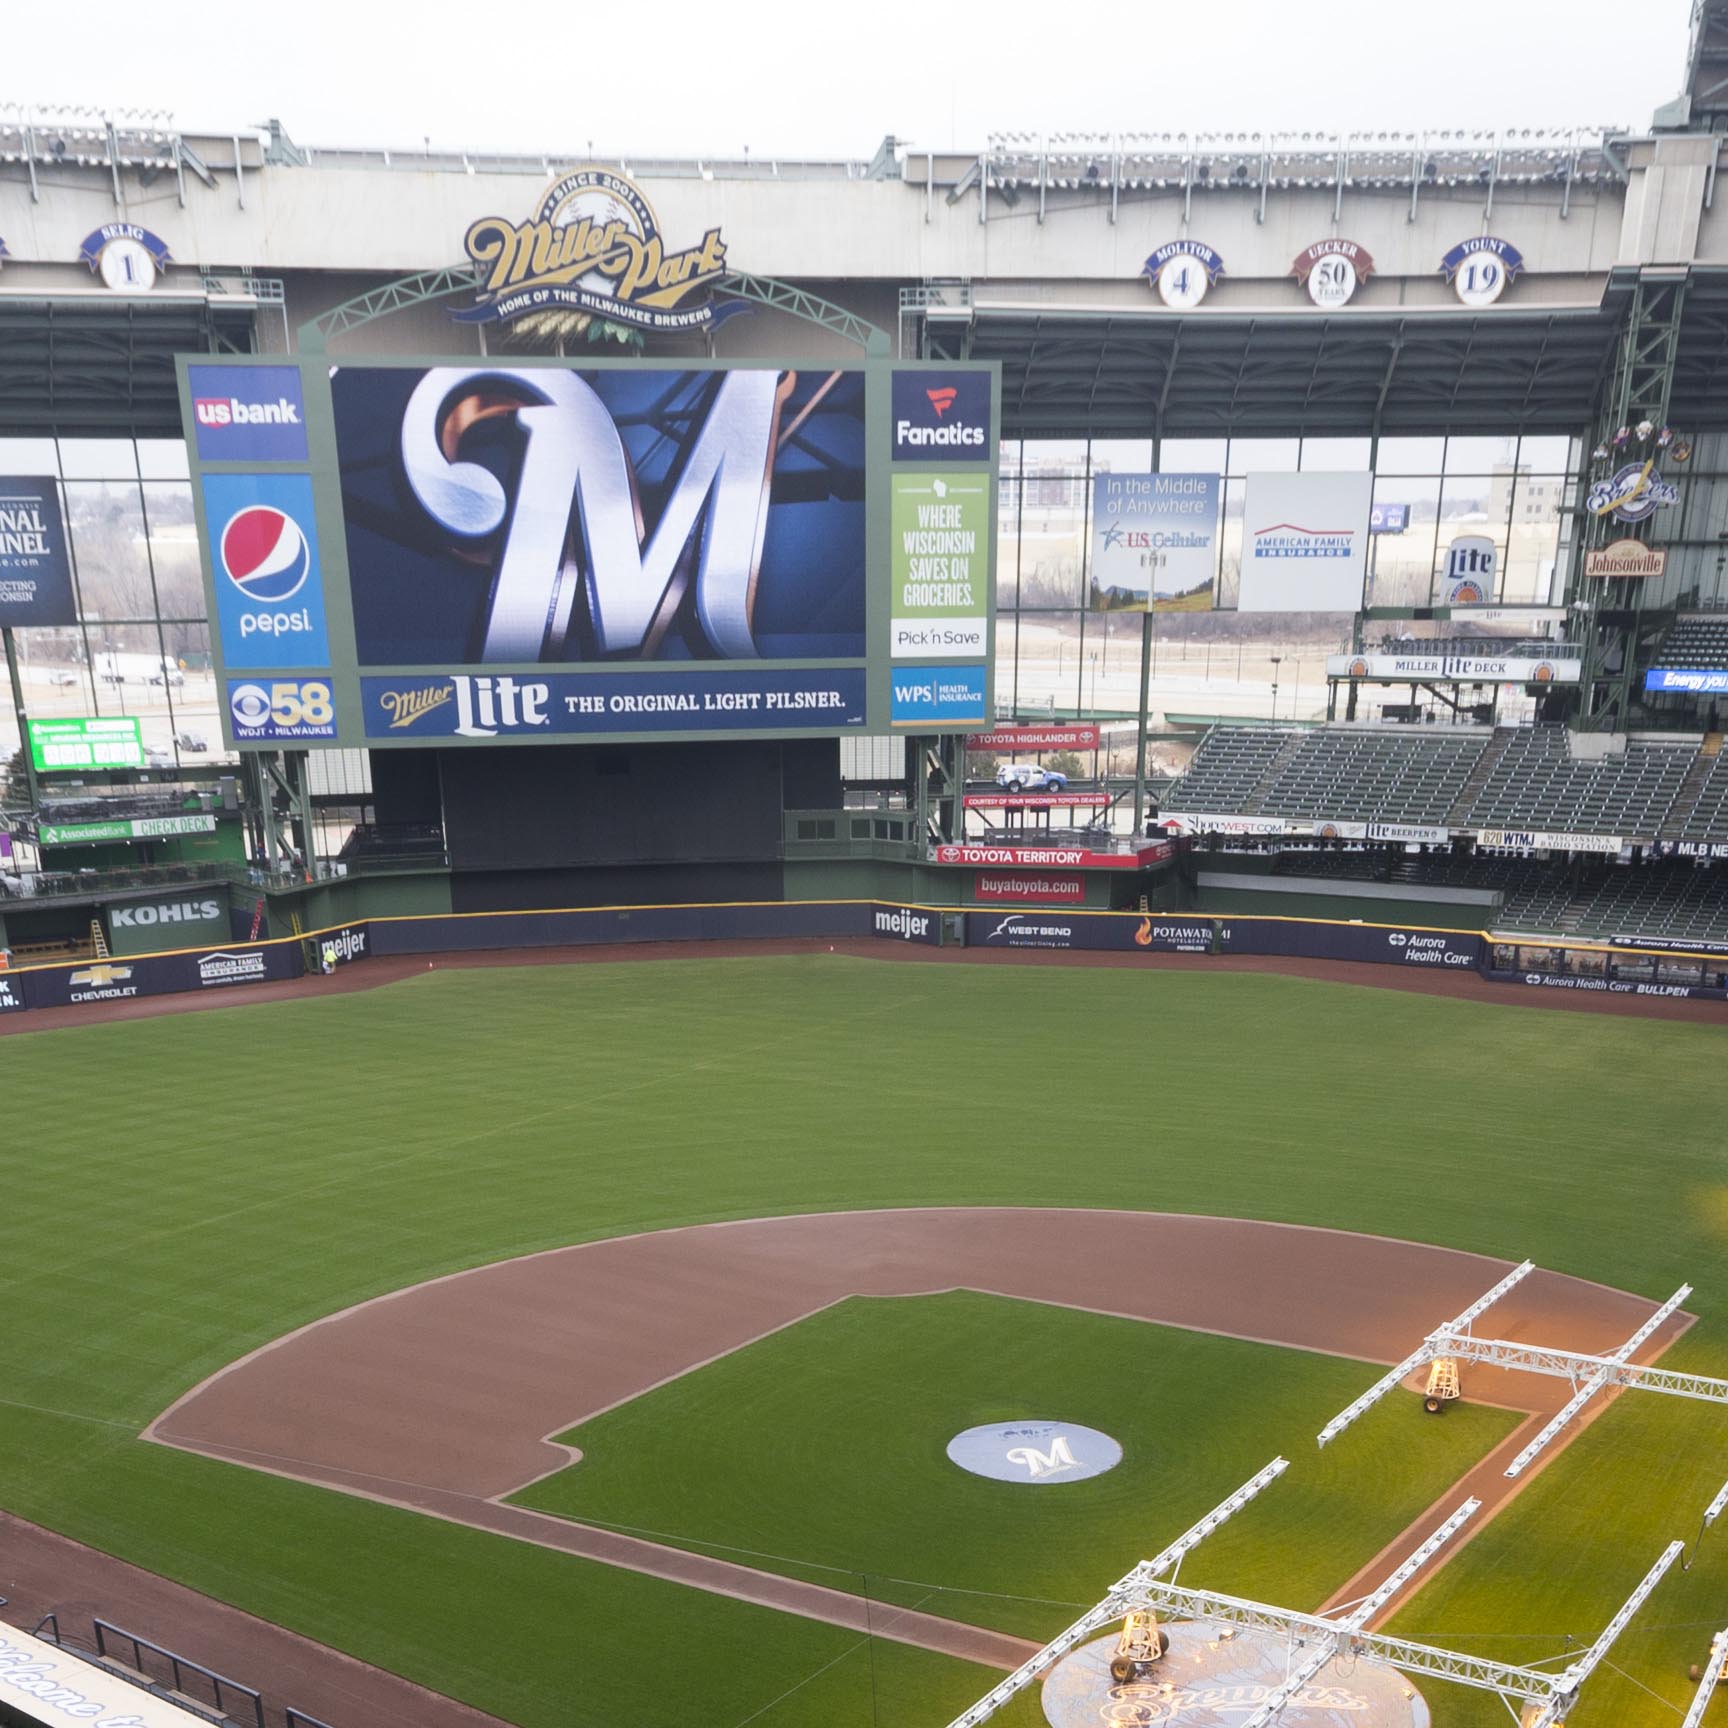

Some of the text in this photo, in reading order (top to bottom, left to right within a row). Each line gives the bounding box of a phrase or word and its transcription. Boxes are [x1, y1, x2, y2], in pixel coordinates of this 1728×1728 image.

[554, 173, 635, 201] SINCE 2001
[102, 223, 143, 240] SELIG
[1156, 242, 1212, 263] MOLITOR
[1308, 240, 1358, 260] UECKER
[1461, 238, 1507, 256] YOUNT
[1172, 268, 1189, 297] 4
[1318, 261, 1346, 287] 50
[1463, 263, 1498, 294] 19
[498, 290, 712, 327] HOME OF THE MILWAUKEE BREWERS
[897, 420, 985, 446] Fanatics
[1107, 478, 1207, 495] In the Middle
[918, 505, 962, 529] WHERE
[1107, 498, 1205, 517] of Anywhere
[903, 531, 975, 556] WISCONSIN
[1256, 537, 1352, 548] AMERICAN FAMILY
[909, 557, 969, 582] SAVES ON
[1448, 548, 1493, 579] Lite
[1588, 552, 1662, 576] Johnsonville
[903, 583, 975, 607] GROCERIES.
[240, 608, 310, 637] pepsi
[898, 630, 980, 645] Pick Save
[1395, 656, 1506, 678] MILLER Lite DECK
[1663, 673, 1705, 690] Energy
[271, 683, 334, 726] 58
[895, 686, 932, 703] WPS
[450, 676, 846, 736] Lite THE ORIGINAL LIGHT PILSNER.
[237, 726, 333, 737] WDJT MILWAUKEE
[979, 734, 1076, 744] TOYOTA HIGHLANDER
[141, 816, 208, 836] CHECK DECK
[1504, 832, 1535, 847] WTMJ
[1678, 842, 1708, 857] MLB
[963, 850, 1083, 864] TOYOTA TERRITORY
[981, 877, 1080, 896] buyatoyota.com
[112, 900, 220, 928] KOHL'S
[876, 908, 929, 939] meijer
[1008, 926, 1071, 937] WEST BEND
[1408, 935, 1445, 948] Aurora
[1405, 948, 1471, 965] Health Care
[71, 986, 137, 1002] CHEVROLET
[1542, 976, 1689, 998] Aurora Health BULLPEN
